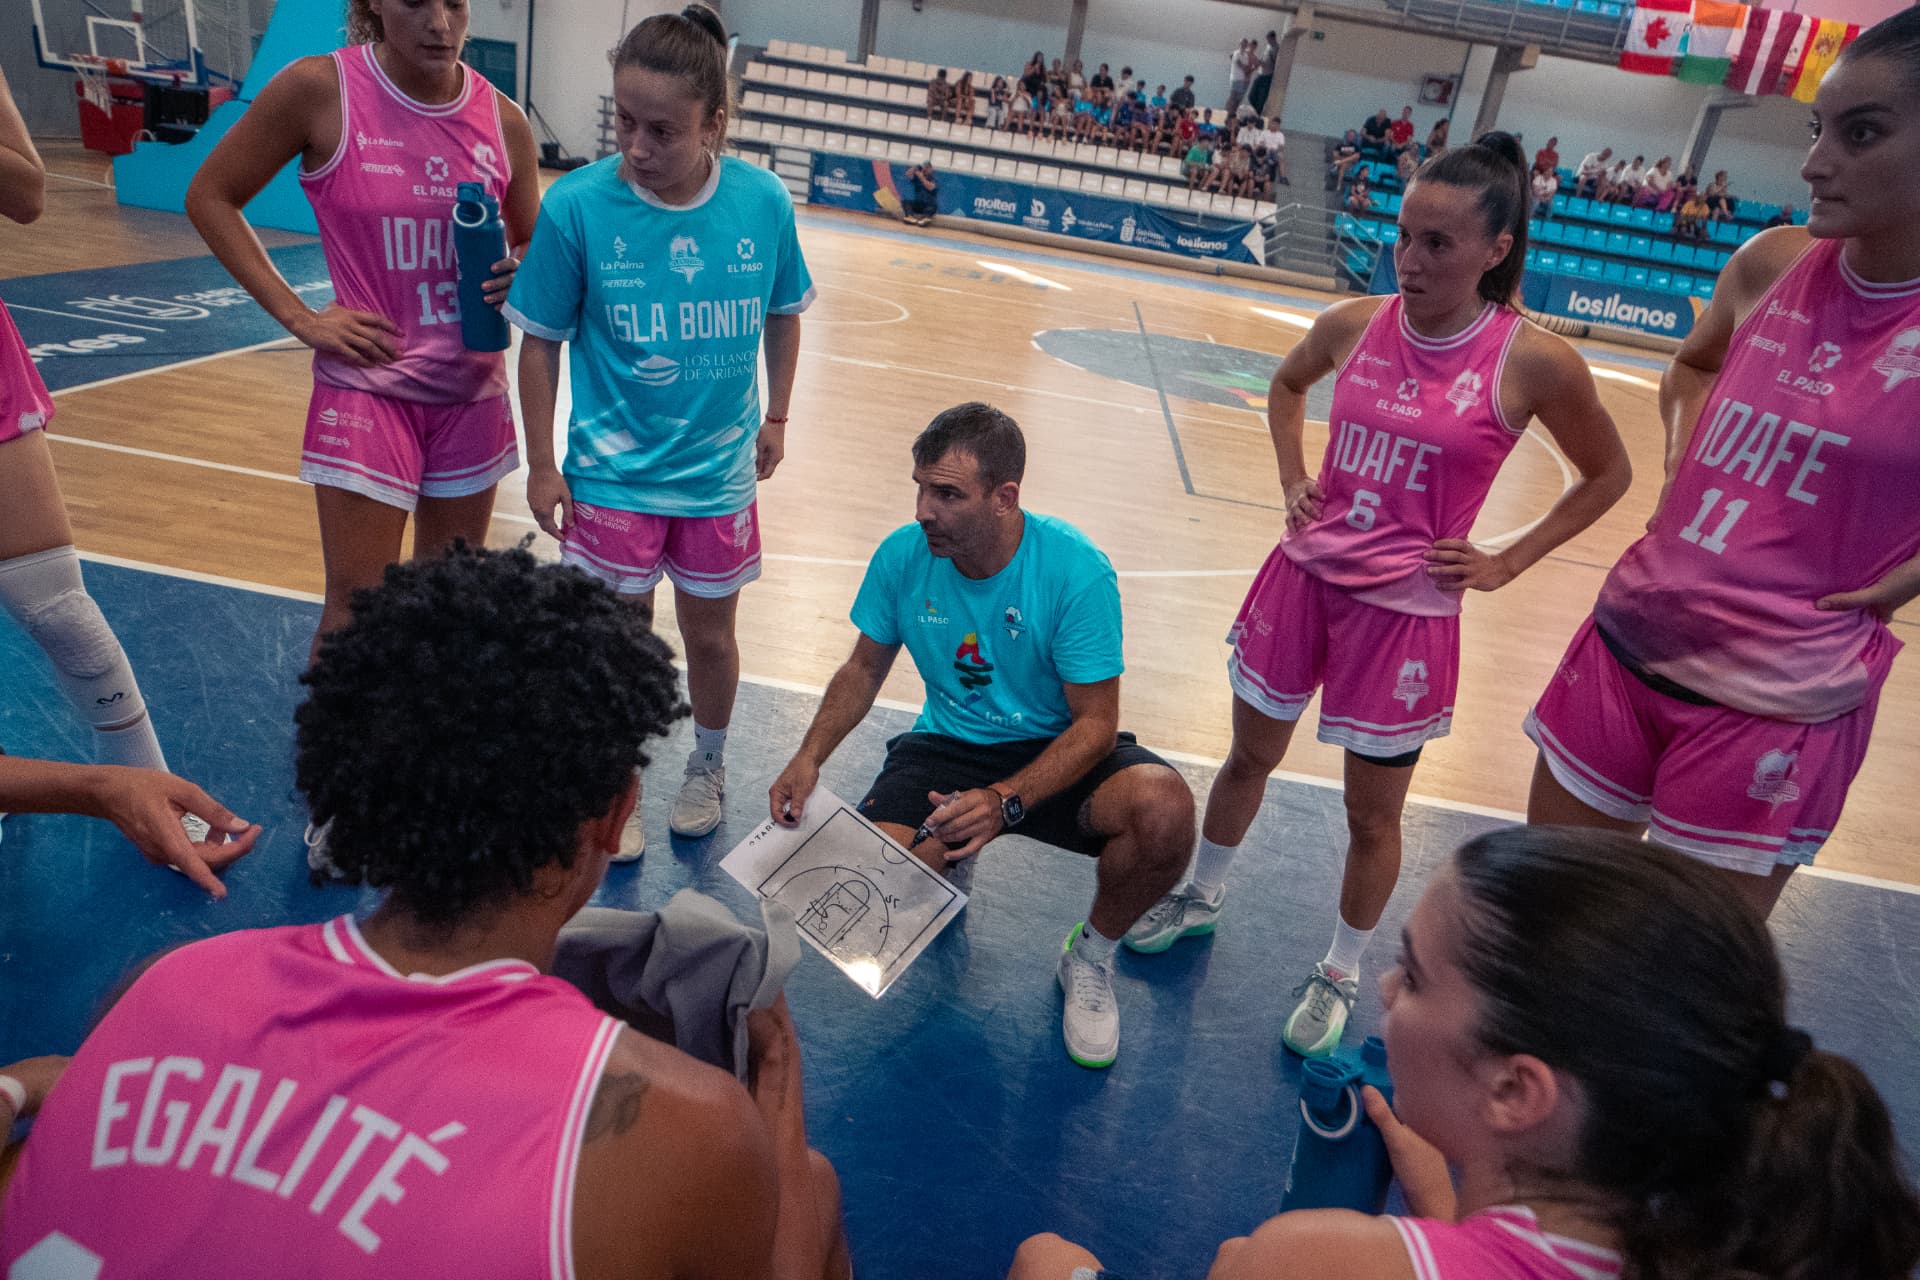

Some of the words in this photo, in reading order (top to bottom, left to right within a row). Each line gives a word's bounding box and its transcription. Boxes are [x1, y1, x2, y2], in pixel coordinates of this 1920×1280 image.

[413, 184, 427, 195] EL
[429, 185, 458, 197] PAS
[973, 197, 1016, 213] molten
[600, 261, 612, 270] La
[613, 259, 645, 270] Palma
[727, 264, 740, 273] EL
[741, 262, 764, 272] PASO
[605, 302, 669, 343] ISLA
[679, 296, 761, 341] BONITA
[1567, 290, 1678, 329] losllanos
[685, 353, 711, 367] LOS
[685, 368, 702, 381] DE
[1775, 369, 1792, 384] EL
[1792, 376, 1835, 396] PASO
[1375, 399, 1389, 410] EL
[1390, 402, 1422, 418] PASO
[1332, 420, 1442, 492] IDAFE
[1695, 397, 1852, 506] IDAFE
[1345, 488, 1381, 532] 6
[1679, 487, 1750, 555] 11
[927, 615, 949, 625] PASO
[90, 1054, 468, 1256] EGALITÉ
